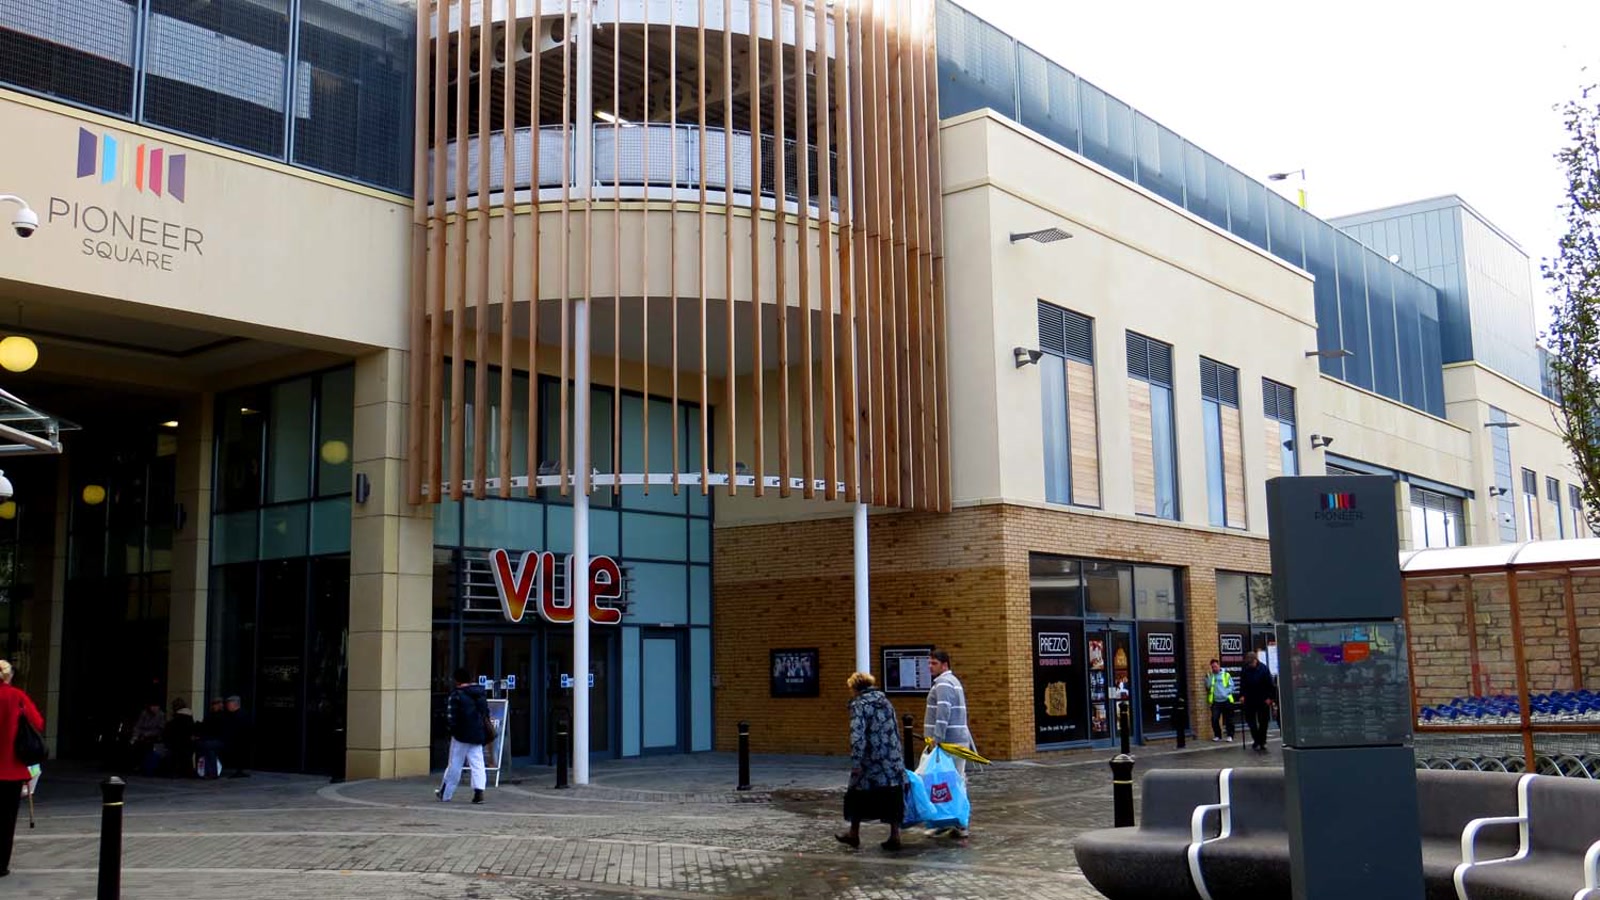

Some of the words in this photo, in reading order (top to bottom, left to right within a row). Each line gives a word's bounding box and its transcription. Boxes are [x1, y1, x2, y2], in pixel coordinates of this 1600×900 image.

[49, 196, 204, 256] PIONEER
[82, 238, 173, 271] SQUARE
[1040, 637, 1068, 652] PREZZO
[1149, 637, 1172, 651] PREZZO
